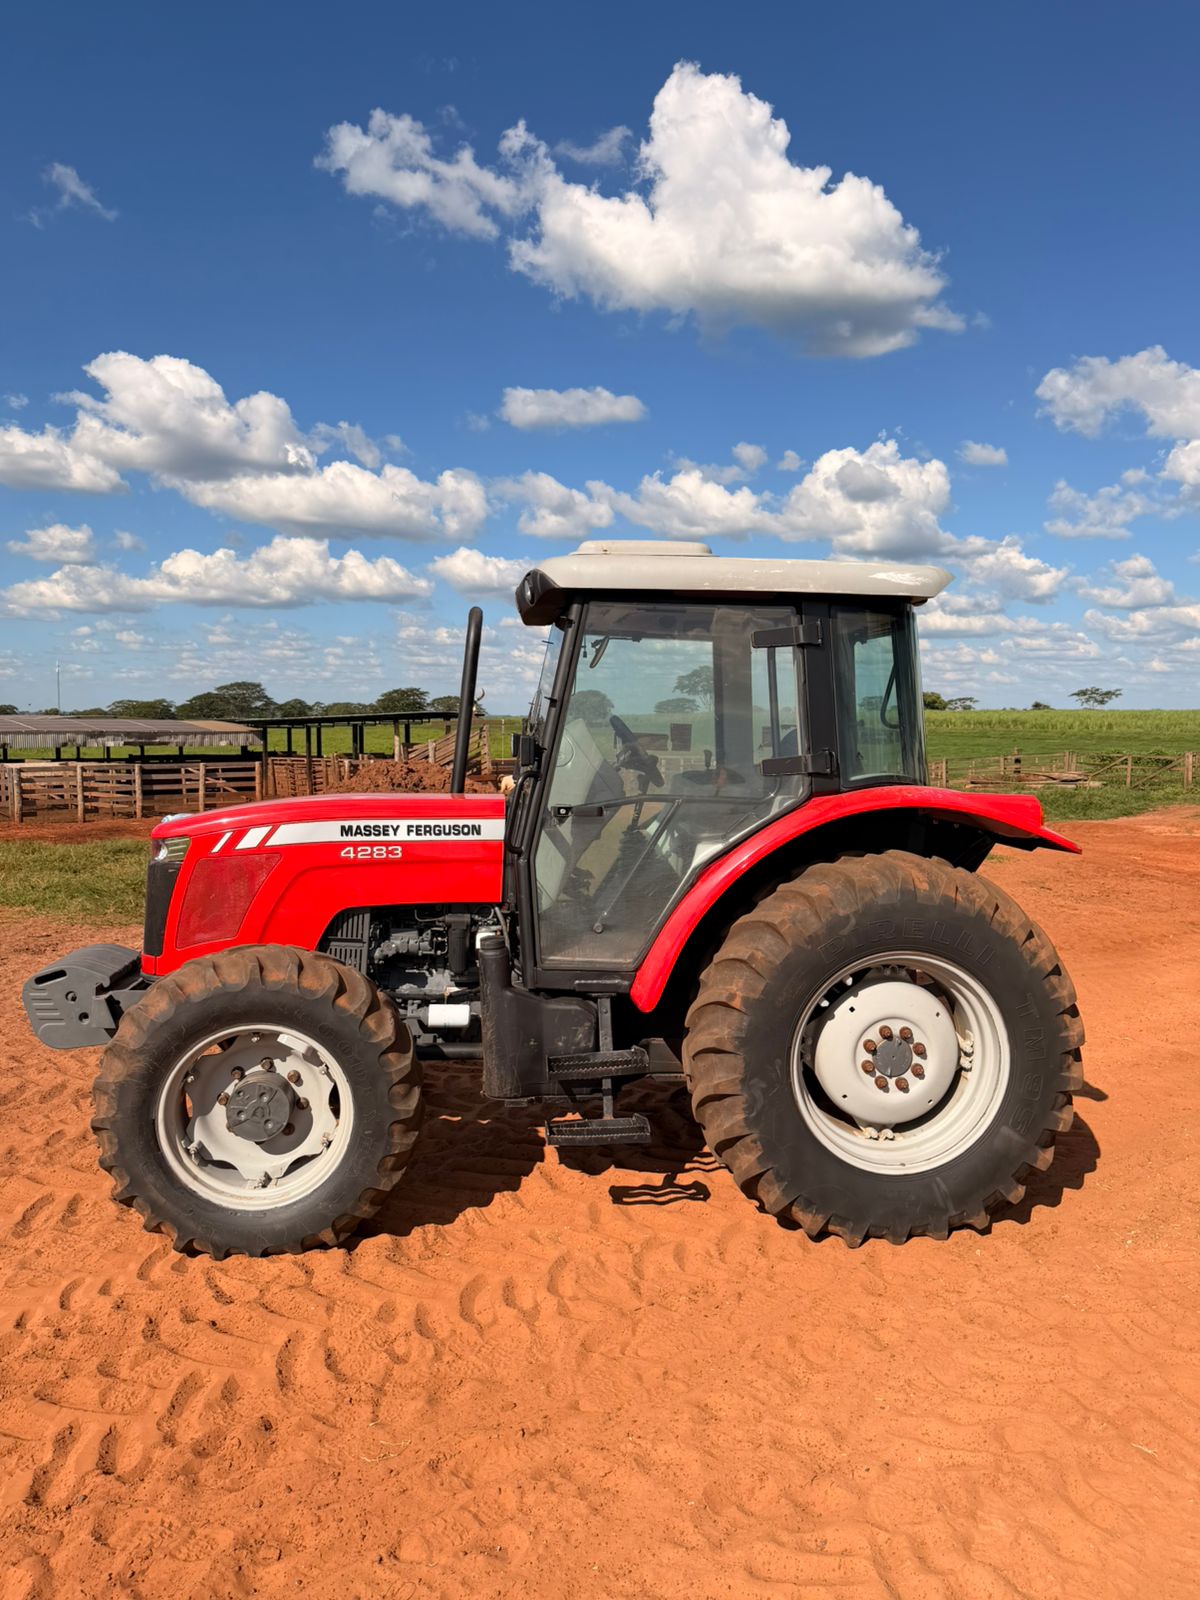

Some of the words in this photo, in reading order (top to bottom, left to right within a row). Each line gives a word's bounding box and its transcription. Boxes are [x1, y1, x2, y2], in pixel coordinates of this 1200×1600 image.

[340, 825, 400, 837] MASSEY
[407, 824, 482, 836] FERGUSON
[340, 846, 403, 859] 4283
[816, 917, 996, 966] PIRELLI
